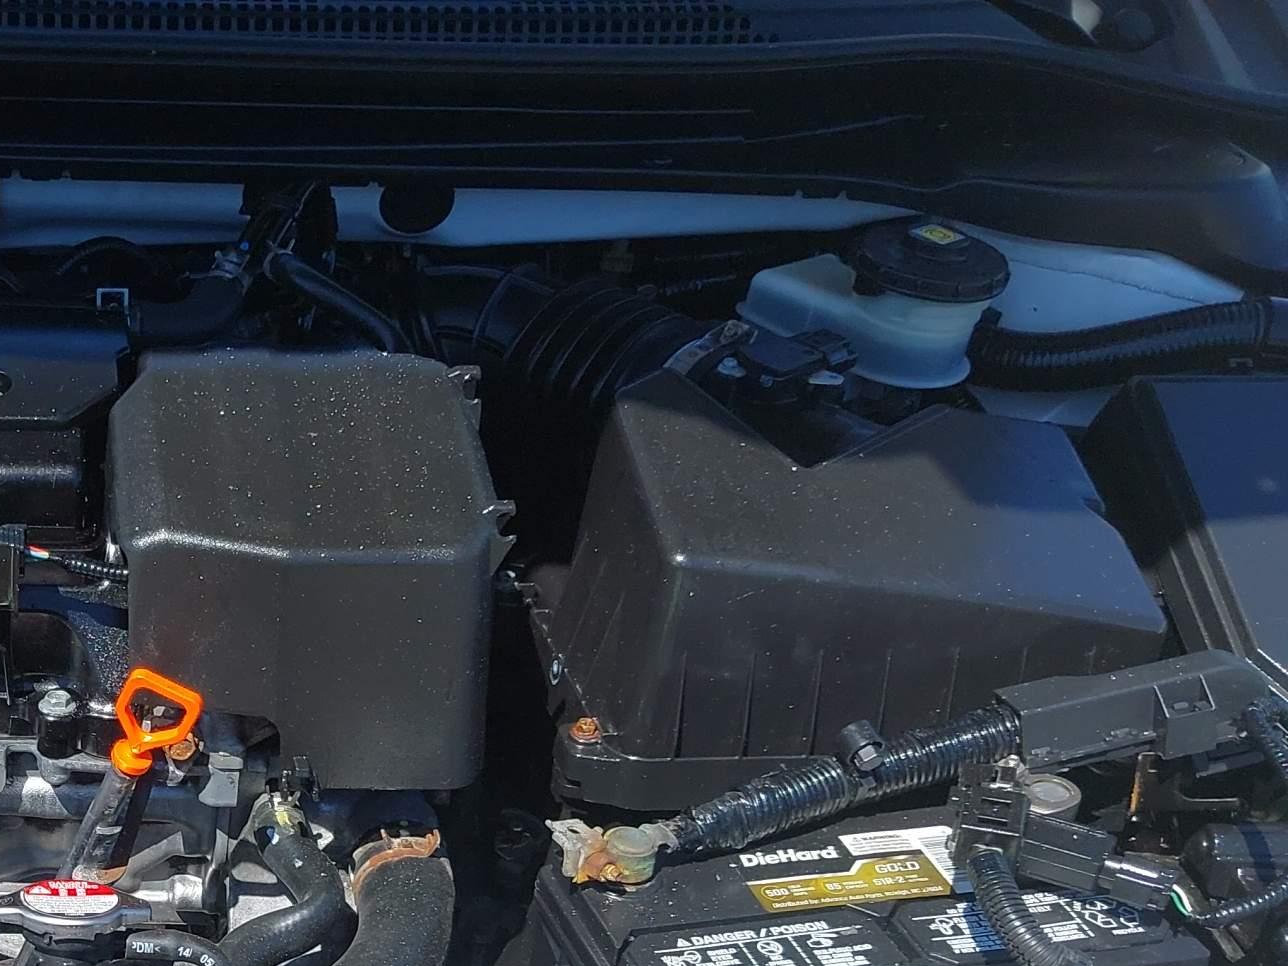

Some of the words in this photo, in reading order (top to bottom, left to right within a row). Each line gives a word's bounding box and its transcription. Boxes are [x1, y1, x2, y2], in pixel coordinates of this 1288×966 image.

[739, 845, 839, 868] DieHard
[874, 861, 920, 874] GOLD
[765, 888, 790, 898] 500
[691, 930, 757, 946] DANGER
[769, 921, 829, 936] POISON
